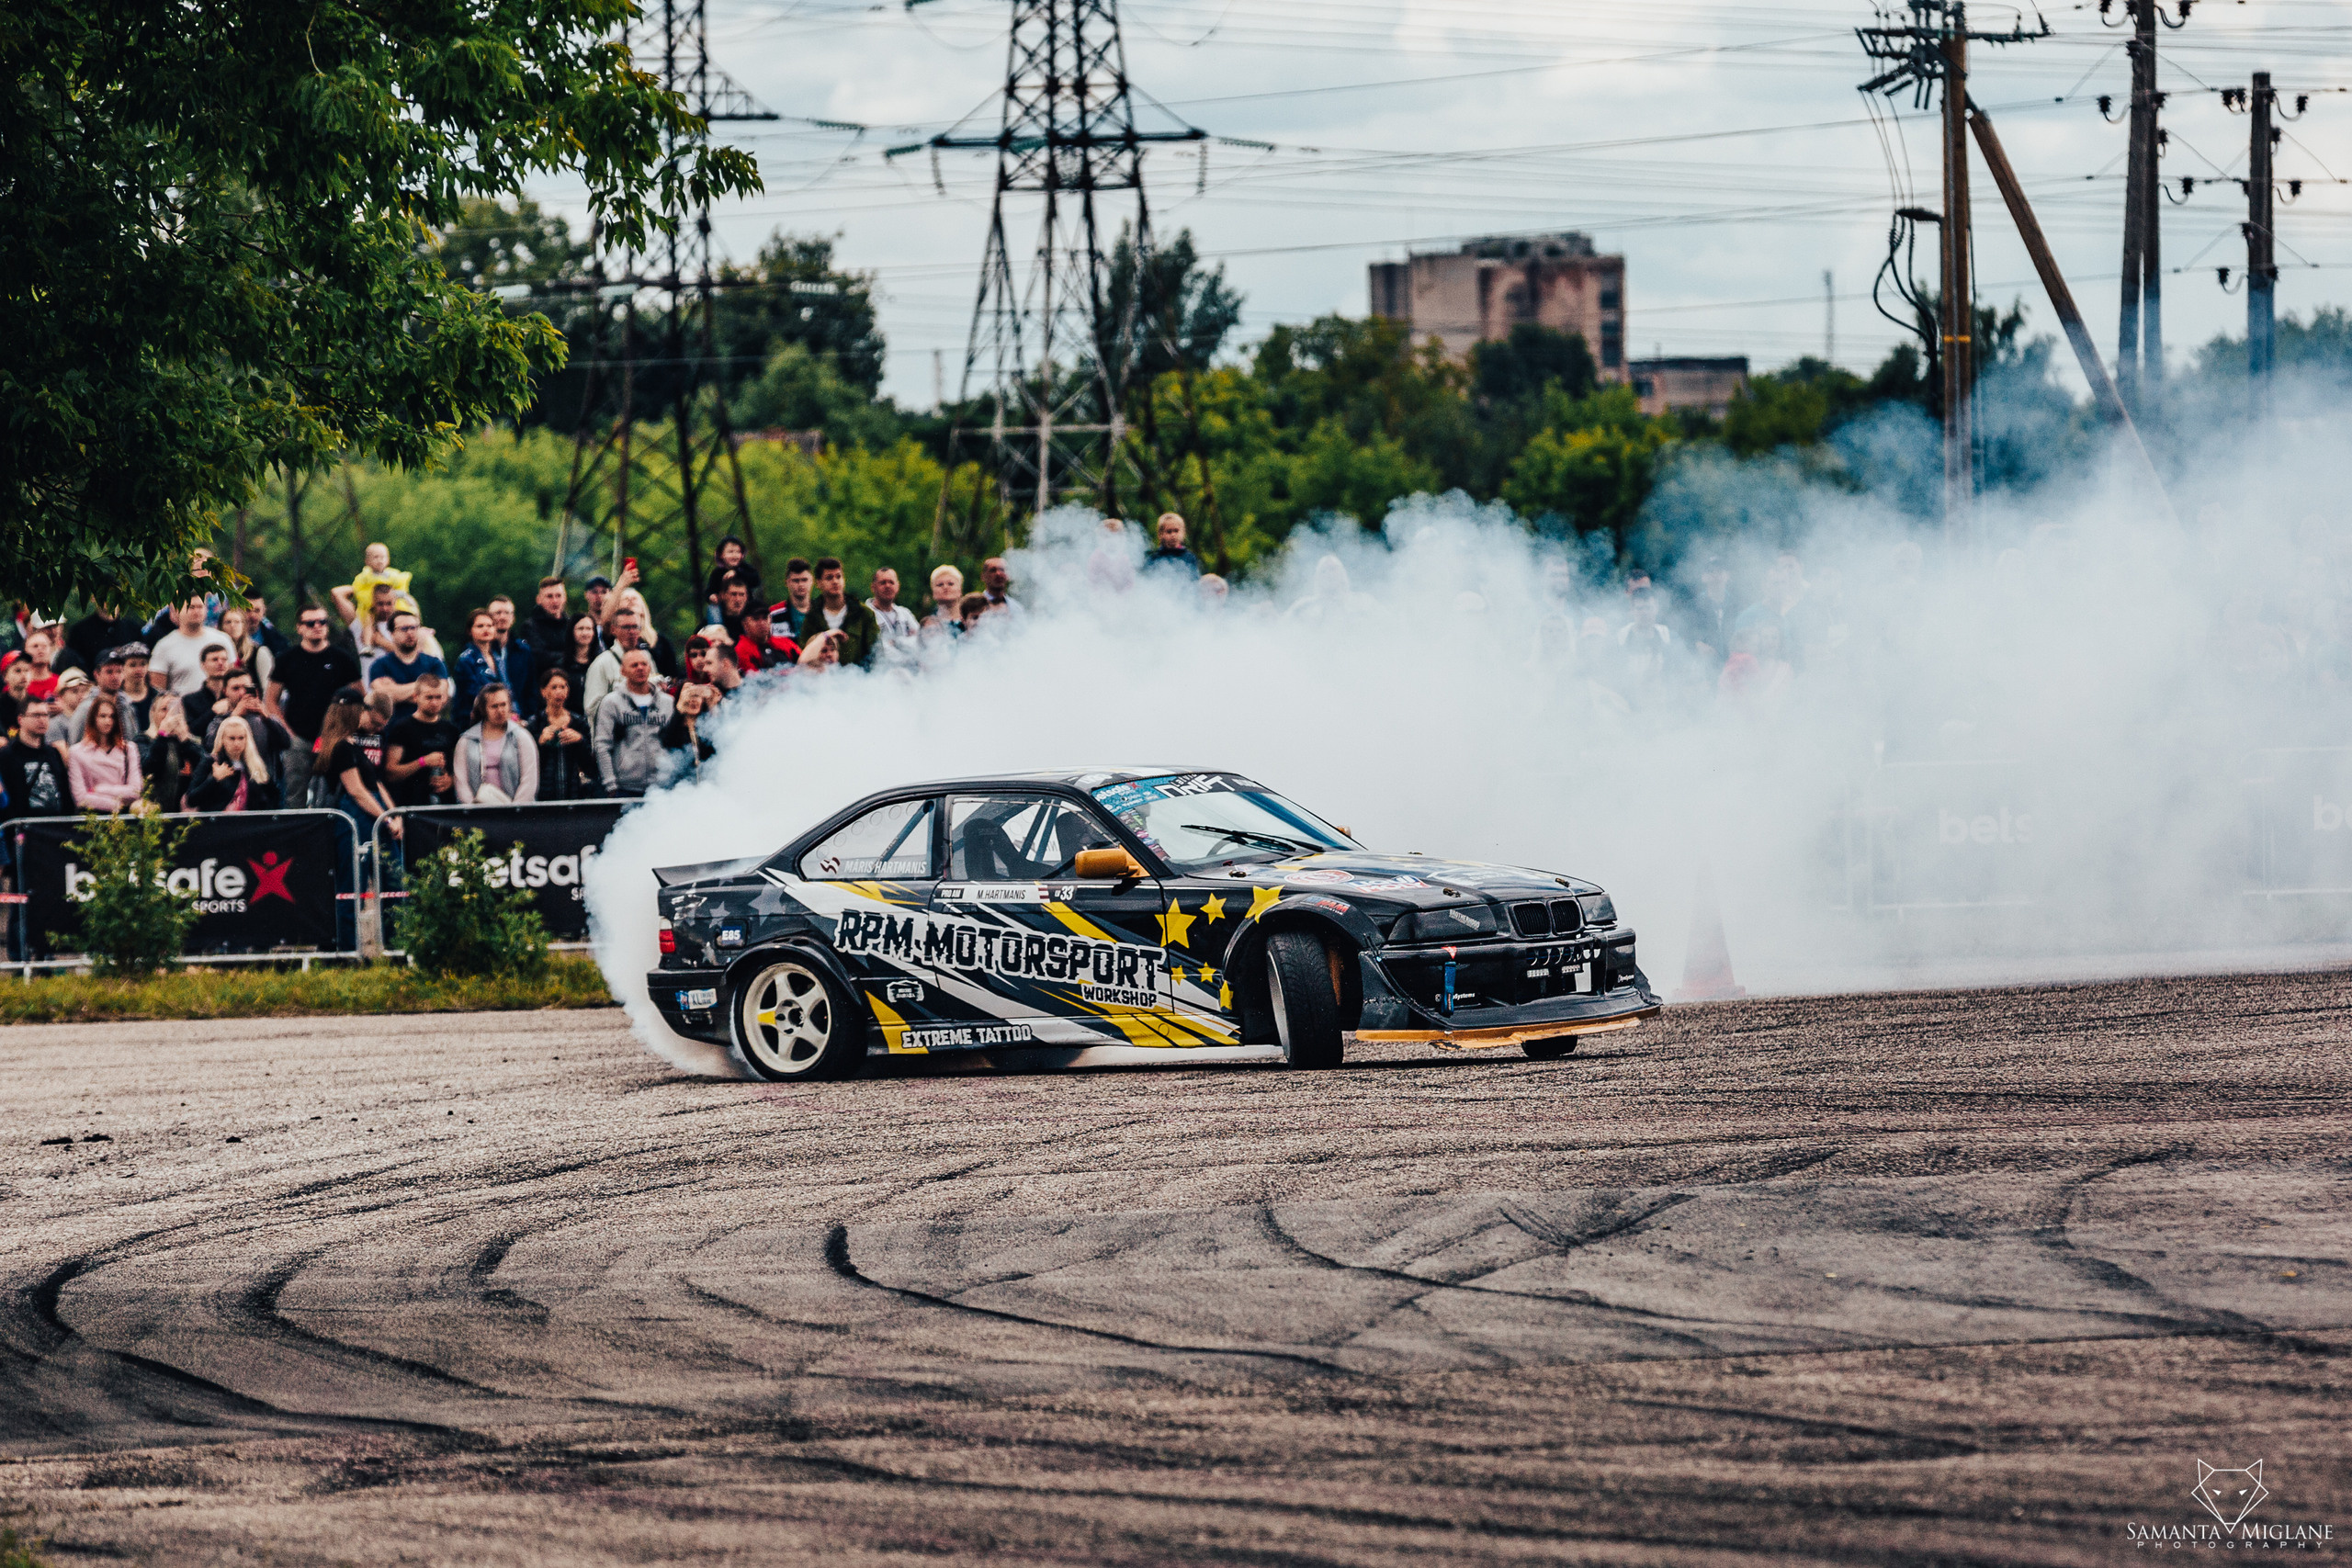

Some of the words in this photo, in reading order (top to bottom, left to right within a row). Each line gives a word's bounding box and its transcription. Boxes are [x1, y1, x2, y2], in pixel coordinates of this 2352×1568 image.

[874, 860, 927, 874] HARTMANIS
[1060, 886, 1074, 900] 33
[721, 930, 741, 941] E85
[1083, 986, 1158, 1008] WORKSHOP
[902, 1028, 973, 1048] EXTREME
[976, 1025, 1032, 1043] TATTOO
